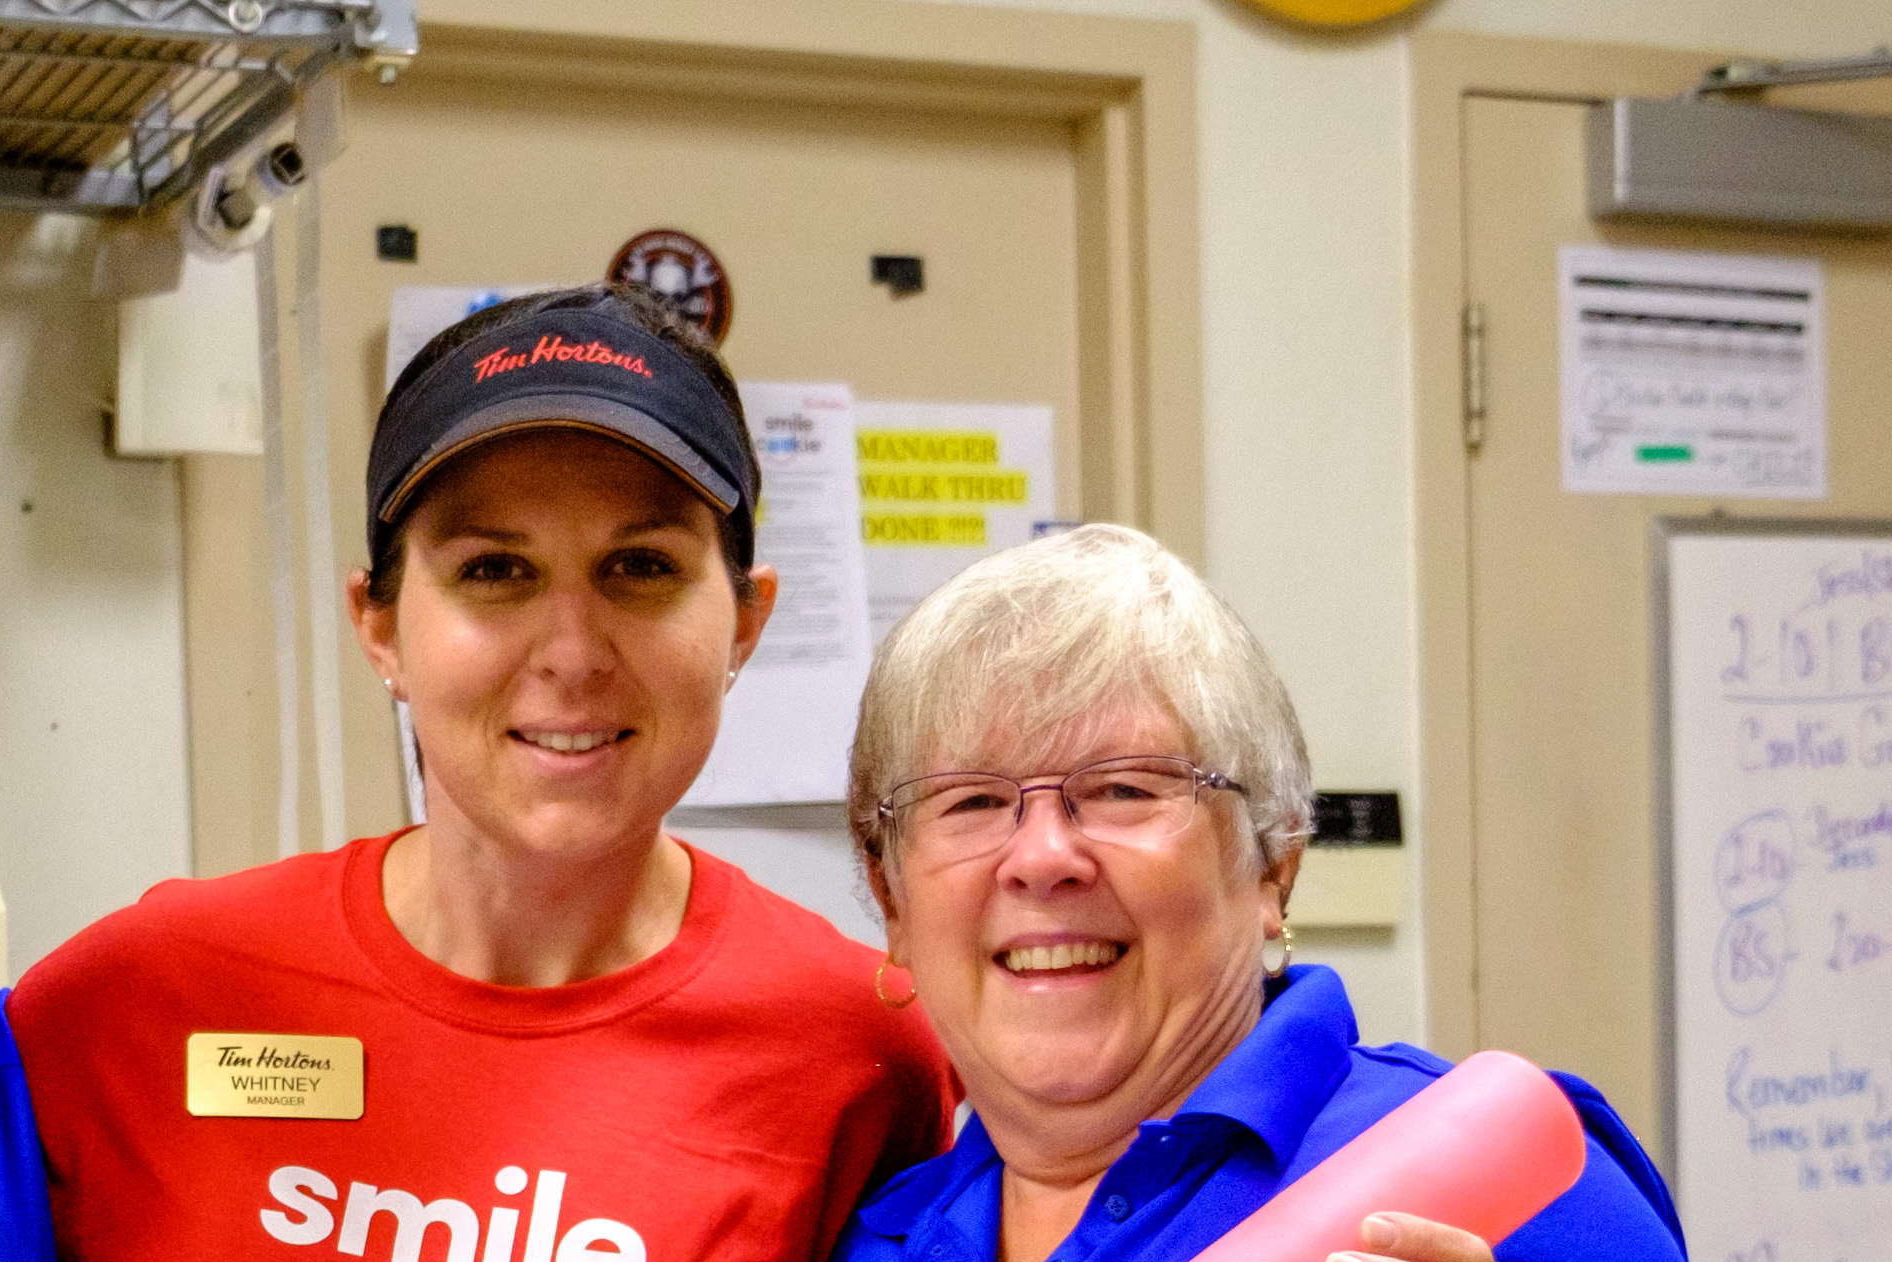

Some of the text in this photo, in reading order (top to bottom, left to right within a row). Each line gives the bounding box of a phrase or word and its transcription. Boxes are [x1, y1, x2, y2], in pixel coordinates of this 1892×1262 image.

[474, 335, 651, 383] Tim Hortons
[858, 436, 997, 463] MANAGER
[860, 474, 1027, 501] WALK THRU
[863, 515, 940, 542] DONE
[217, 1046, 333, 1071] Tim Hortons
[231, 1076, 321, 1092] WHITNEY
[246, 1095, 306, 1106] MANAGER
